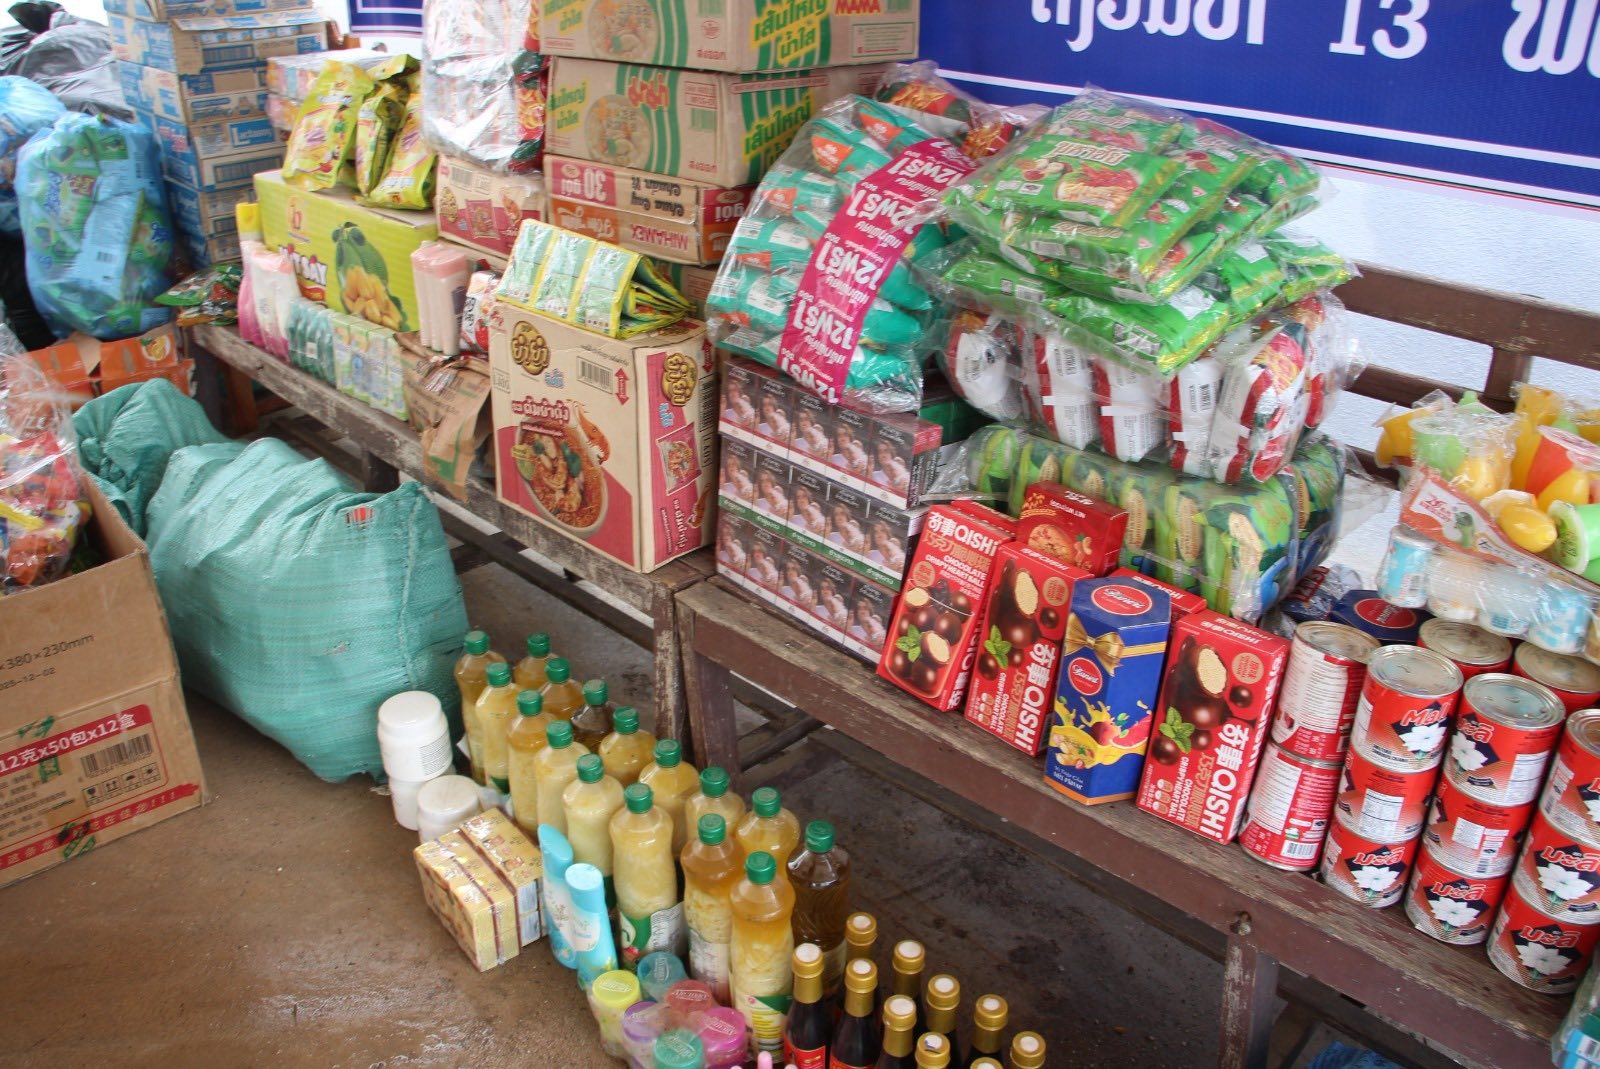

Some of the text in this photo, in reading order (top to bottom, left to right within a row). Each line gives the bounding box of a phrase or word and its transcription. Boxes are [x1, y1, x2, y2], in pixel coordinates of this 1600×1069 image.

[583, 167, 607, 202] 30
[943, 555, 987, 580] CHOCOLATE
[996, 693, 1010, 735] CHOCOLATE
[1178, 756, 1190, 782] CRISPY
[1172, 780, 1185, 806] HEART
[1176, 778, 1194, 824] CHOCOLATE
